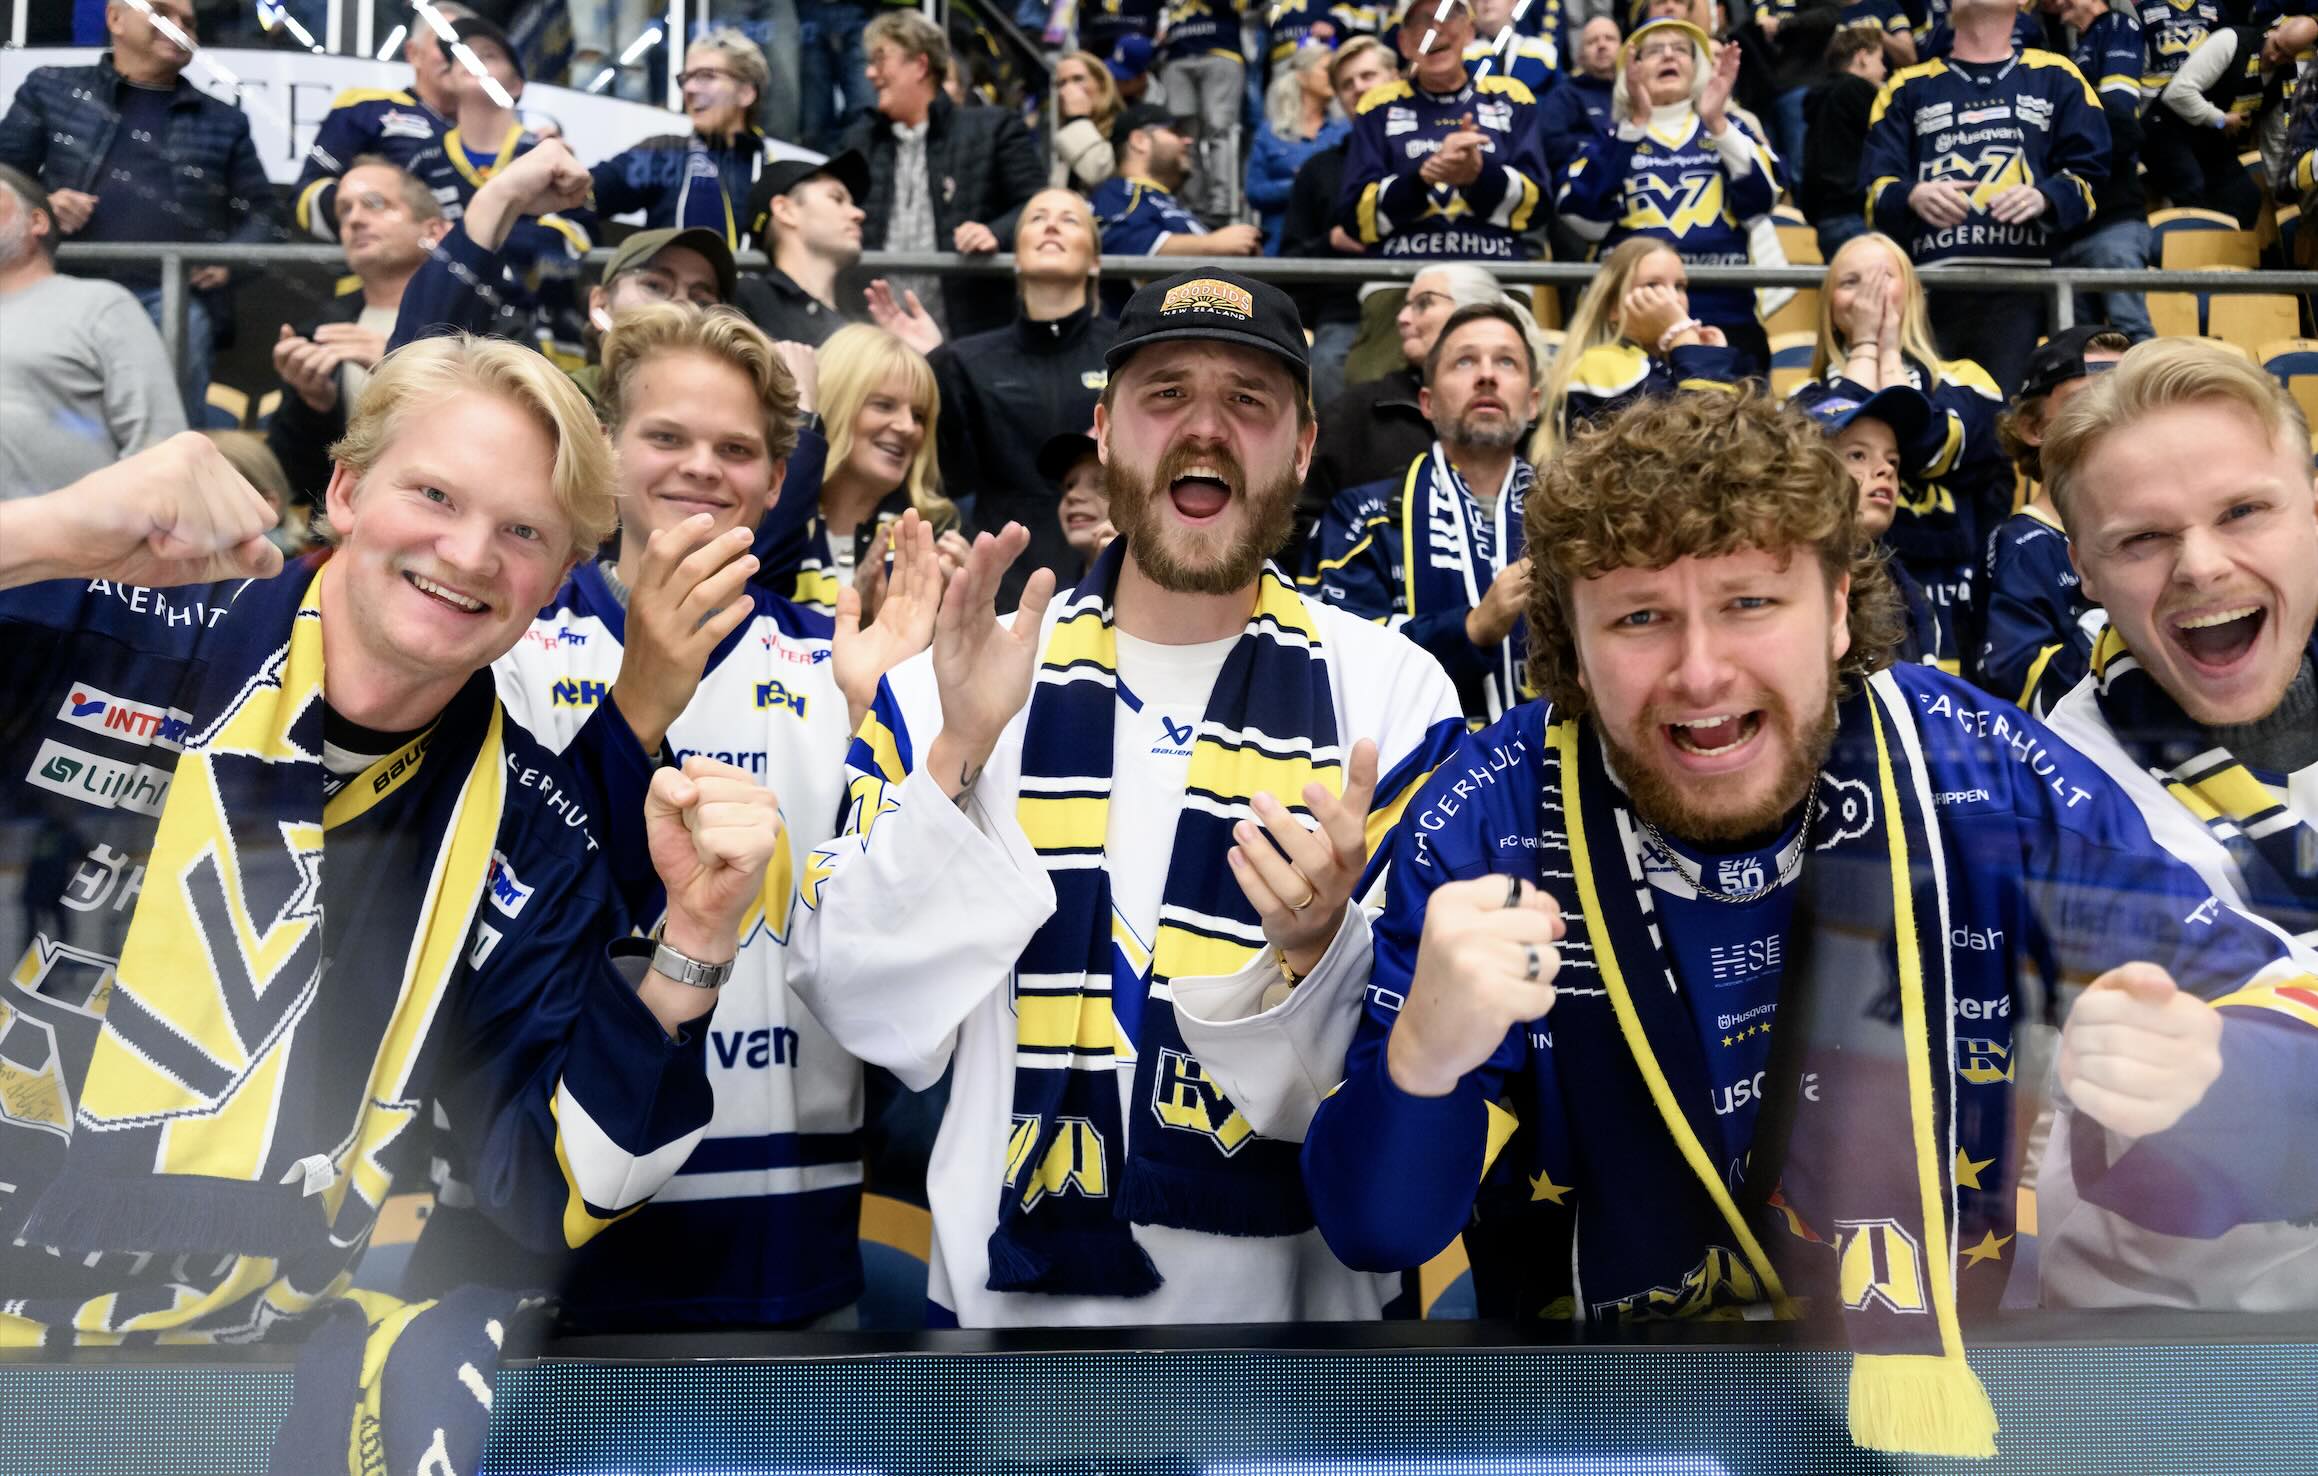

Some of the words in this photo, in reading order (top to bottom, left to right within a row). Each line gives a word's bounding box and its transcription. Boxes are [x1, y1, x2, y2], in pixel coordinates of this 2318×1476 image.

[1165, 285, 1250, 312] GOODLIDS
[1163, 308, 1188, 317] NEW
[1193, 306, 1247, 321] ZEALAND
[1718, 866, 1765, 896] 50
[1710, 933, 1782, 980] HSE
